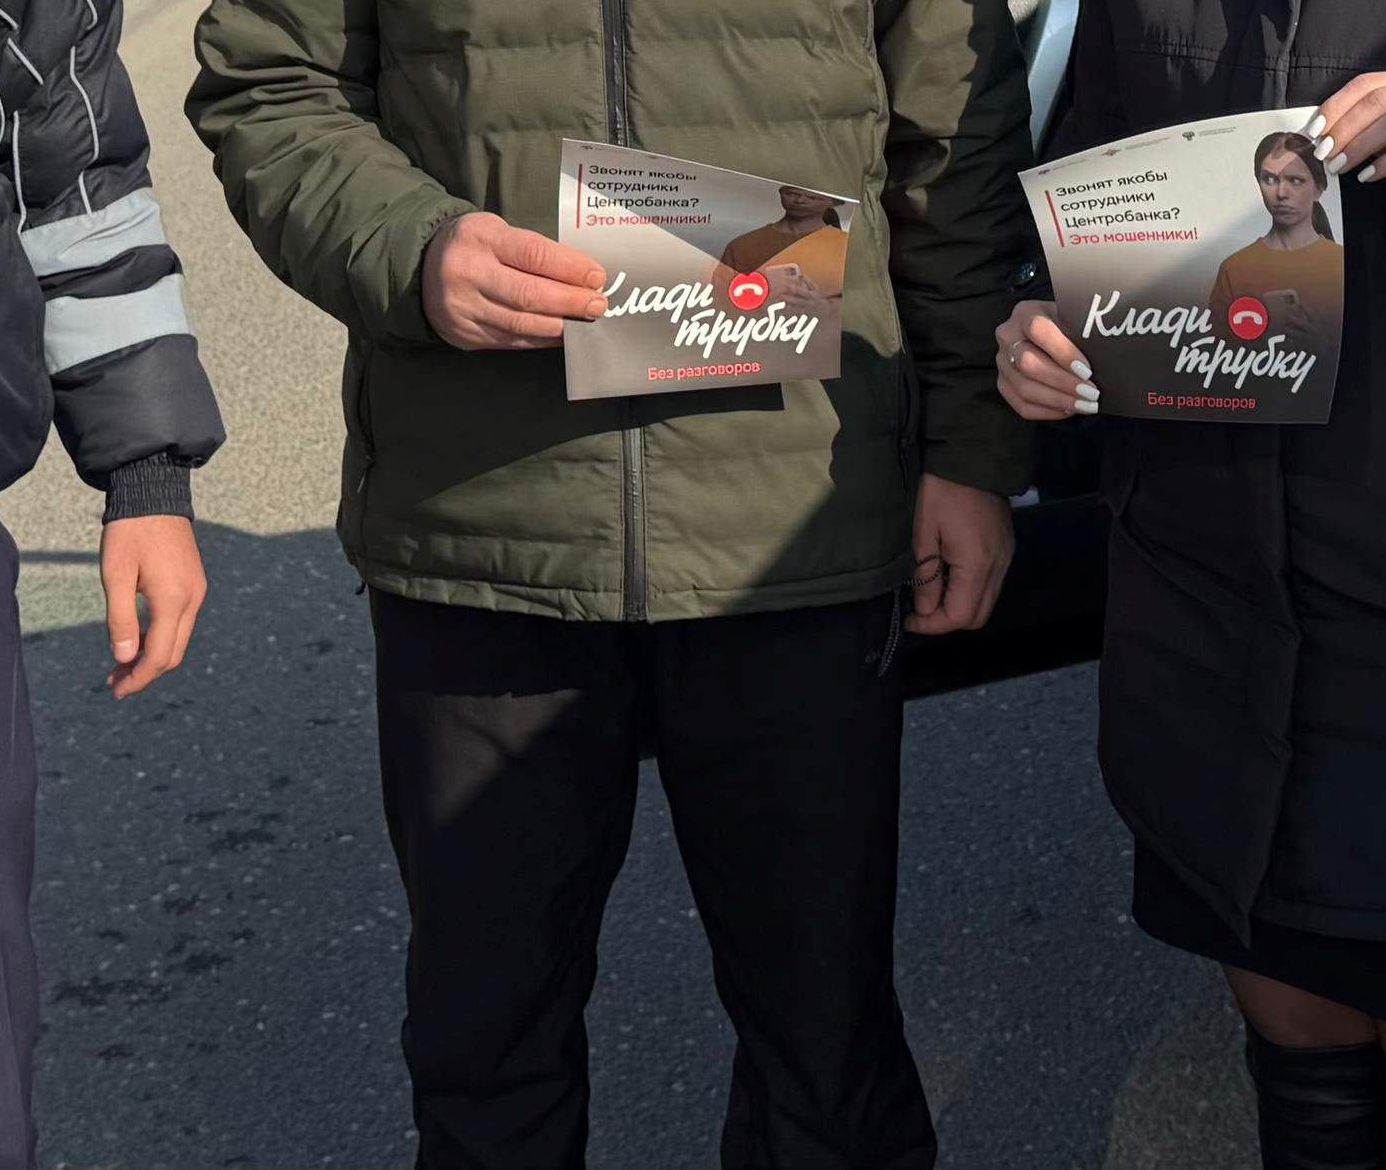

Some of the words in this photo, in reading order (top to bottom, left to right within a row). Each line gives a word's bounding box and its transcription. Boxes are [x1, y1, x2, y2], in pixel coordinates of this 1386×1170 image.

[588, 165, 644, 177] Звонят
[648, 170, 696, 181] якобы
[587, 181, 679, 193] сотрудники
[1055, 179, 1113, 197] Звонят
[1117, 170, 1168, 187] якобы
[587, 196, 699, 209] Центробанка?
[1061, 190, 1155, 212] сотрудники
[586, 214, 615, 227] Это
[619, 213, 712, 225] мошенники!
[1065, 207, 1181, 229] Центробанка?
[1070, 232, 1100, 246] Это
[1103, 227, 1198, 243] мошенники!
[1082, 290, 1212, 348] Клади
[673, 302, 819, 359] трубку
[647, 367, 675, 381] Без
[677, 361, 761, 380] разговоров
[1174, 334, 1317, 394] трубку
[1147, 392, 1174, 406] Без
[1177, 394, 1256, 410] разговоров
